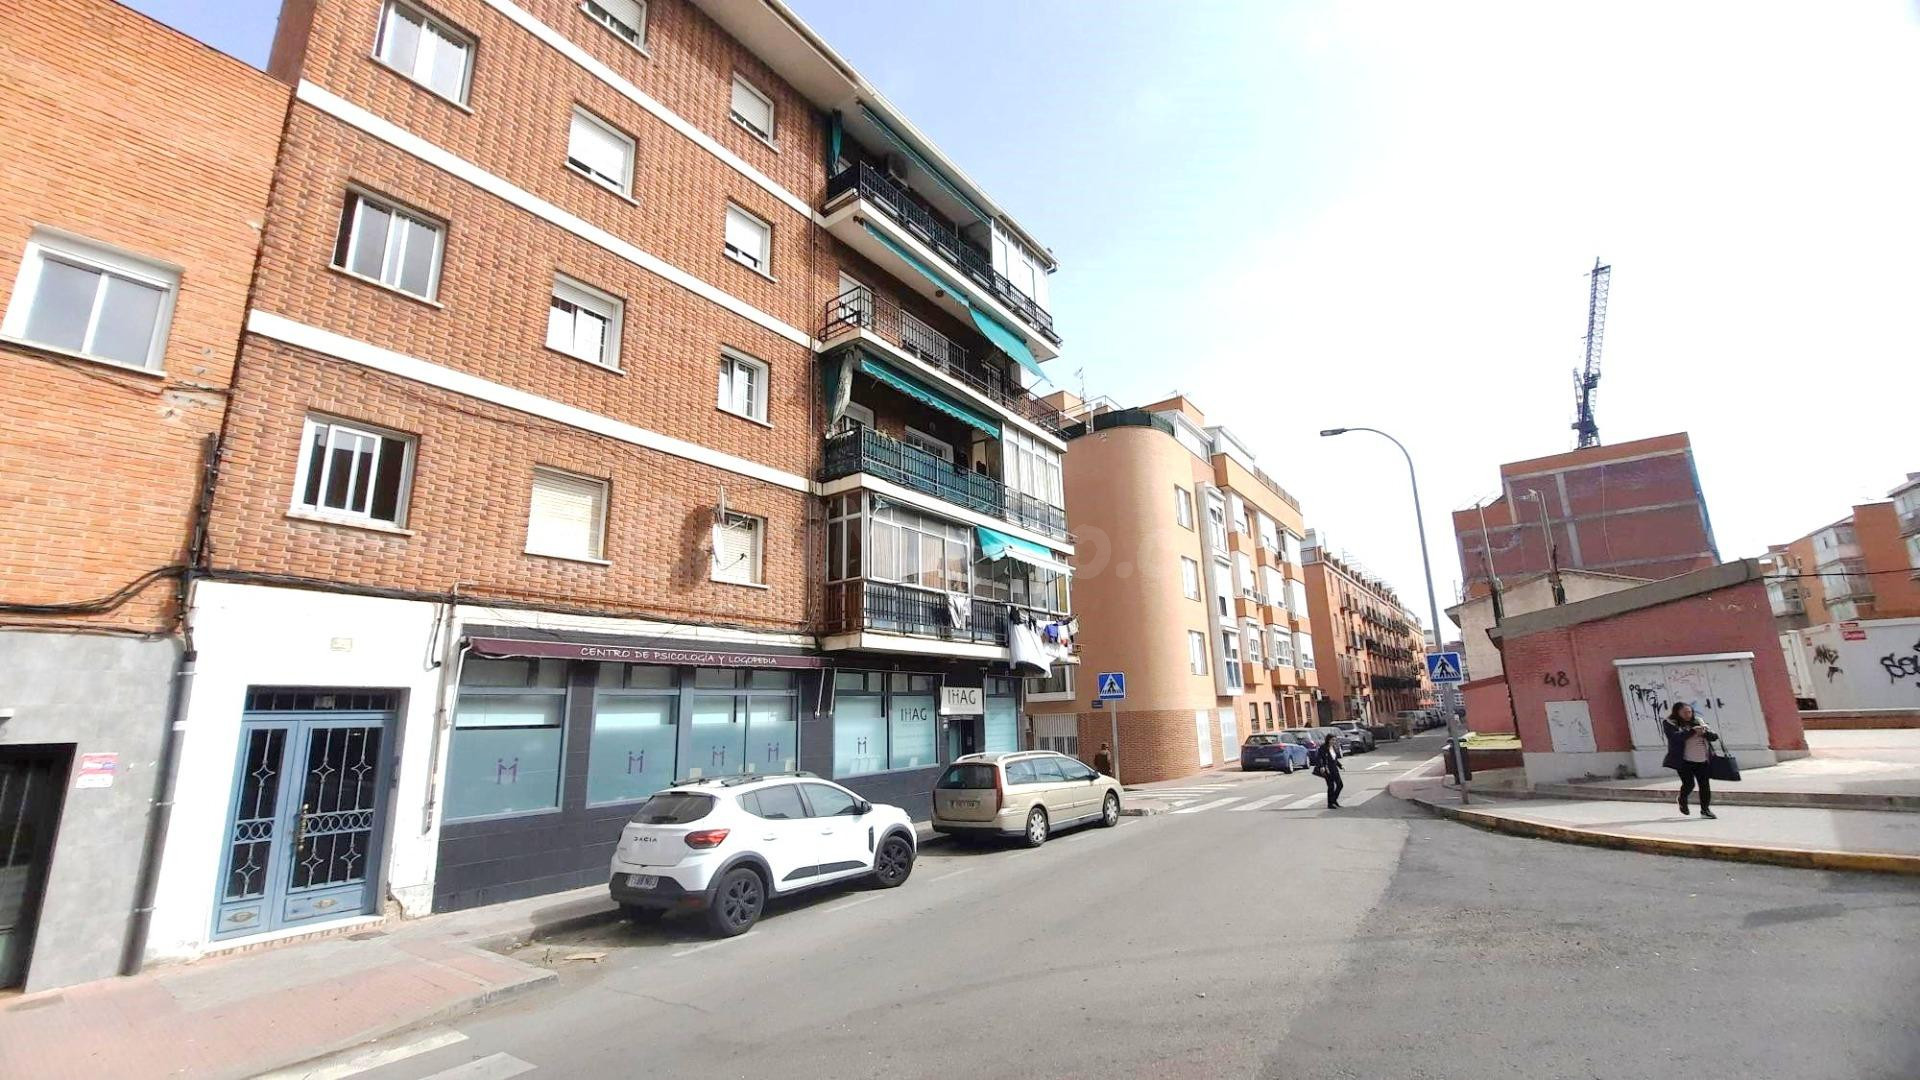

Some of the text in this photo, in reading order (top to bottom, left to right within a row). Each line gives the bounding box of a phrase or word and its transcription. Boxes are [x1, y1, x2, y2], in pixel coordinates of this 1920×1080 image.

[580, 647, 631, 658] CENTRO
[634, 651, 650, 659] DE
[718, 655, 725, 665] Y
[728, 657, 777, 665] LOGOPEDIA
[1544, 671, 1570, 687] 48
